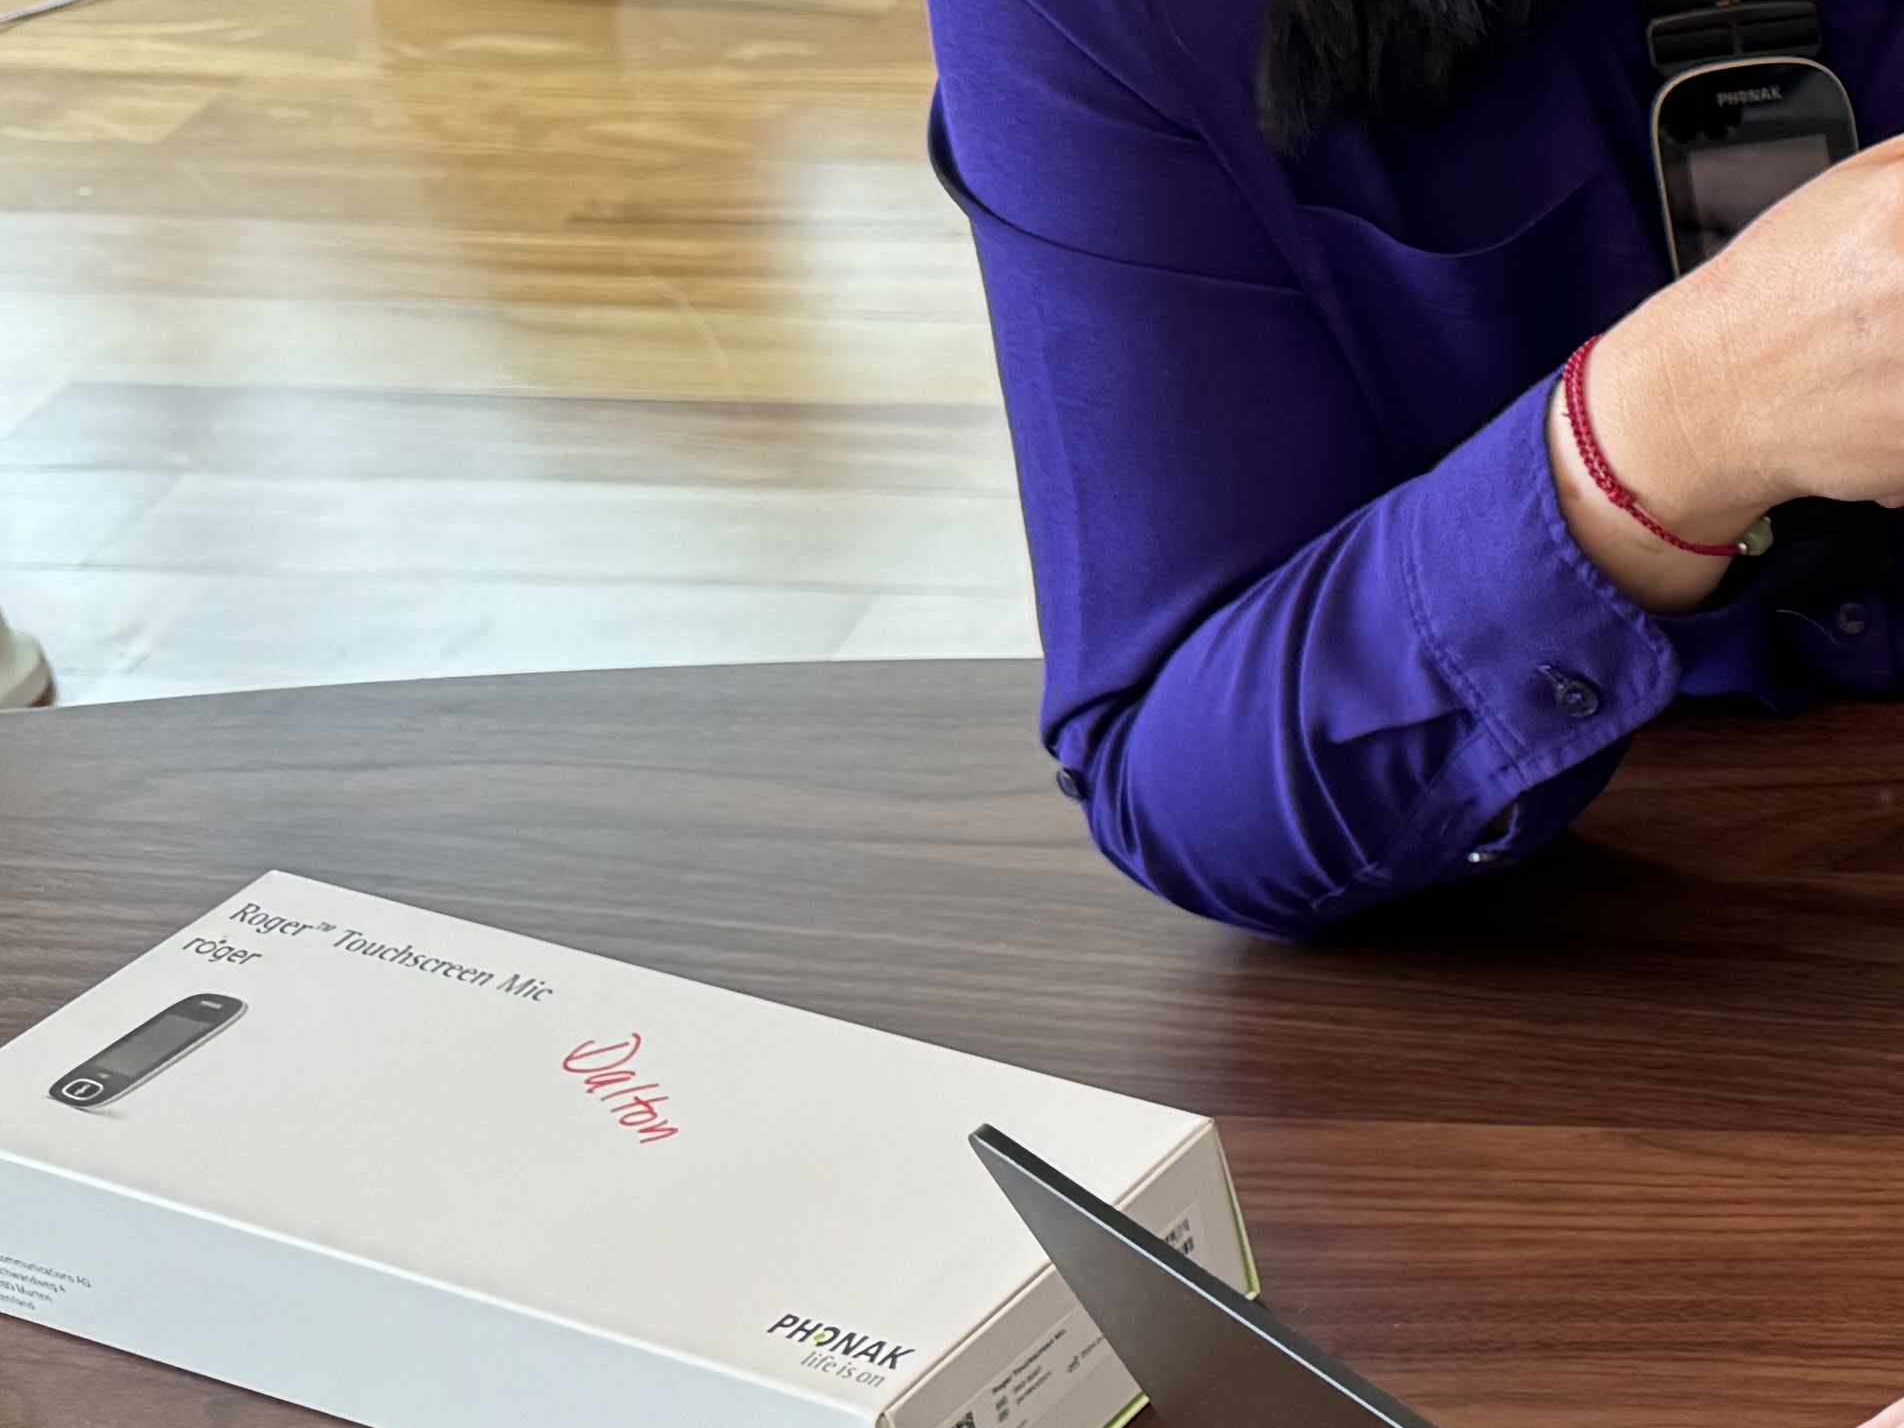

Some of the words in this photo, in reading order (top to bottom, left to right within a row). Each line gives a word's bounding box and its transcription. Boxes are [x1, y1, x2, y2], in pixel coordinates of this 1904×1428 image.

[333, 930, 494, 986] Touchscreen
[496, 974, 552, 1001] Mic
[562, 1032, 679, 1144] Dalton
[766, 1314, 914, 1369] PHONAK
[800, 1351, 836, 1372] life
[836, 1362, 854, 1378] is
[856, 1372, 885, 1387] on
